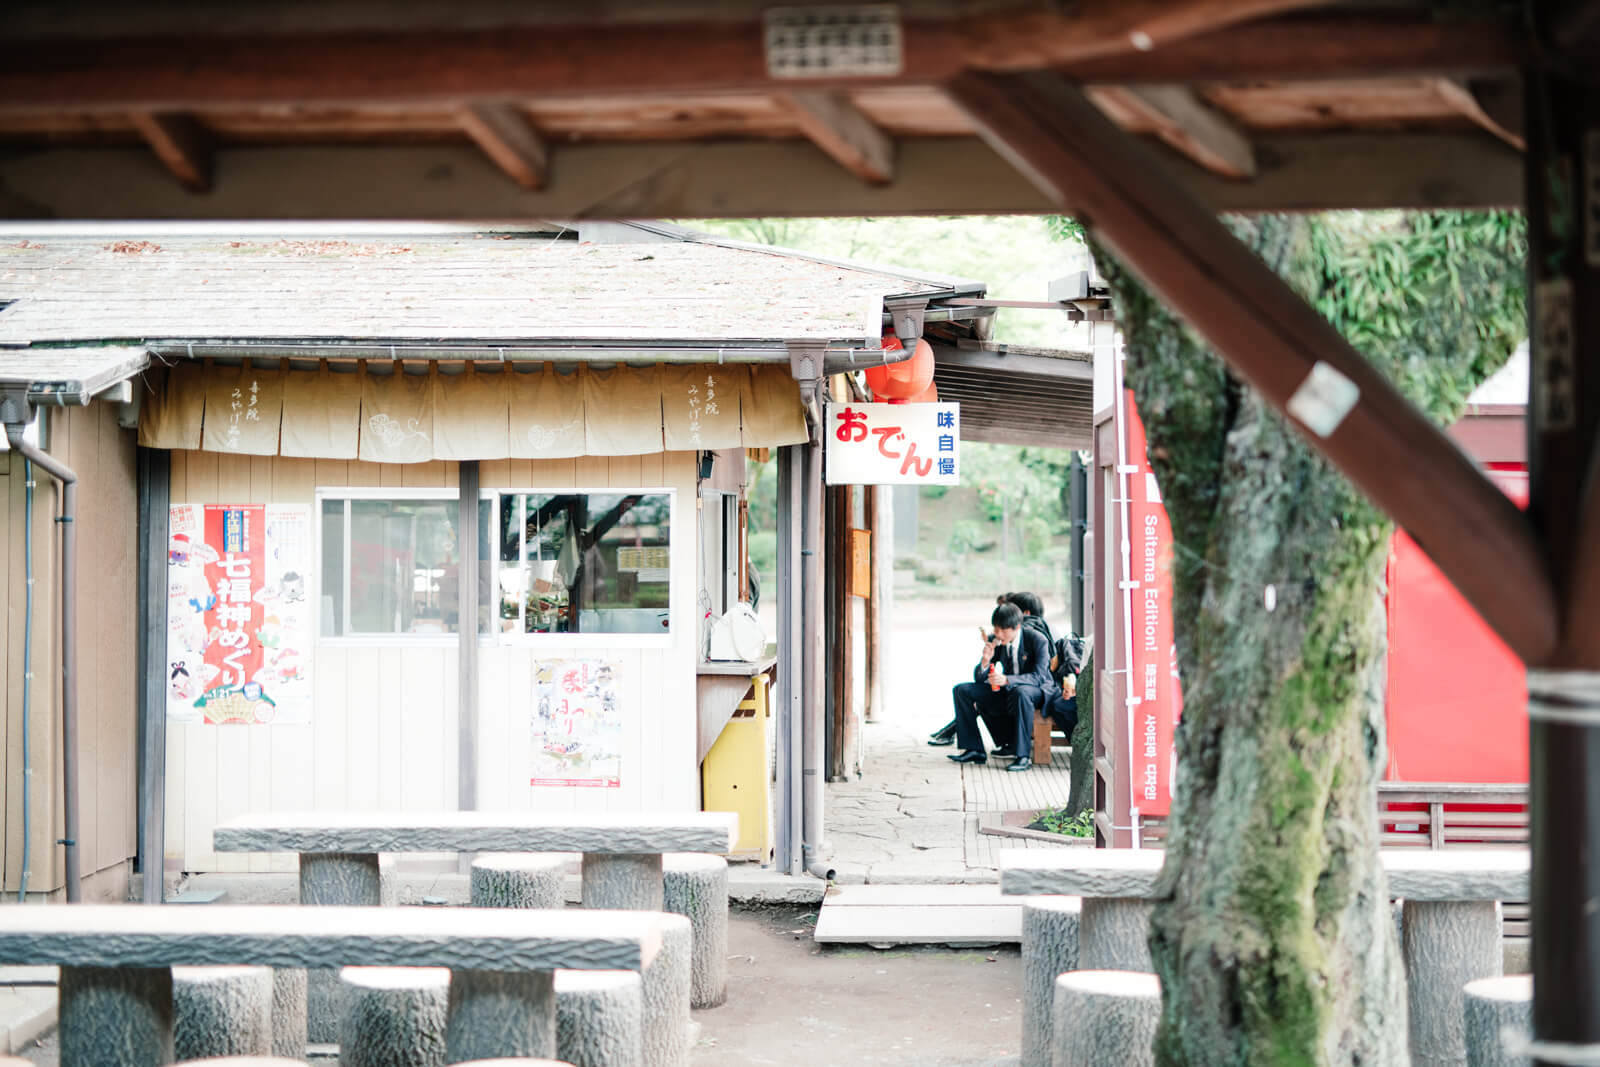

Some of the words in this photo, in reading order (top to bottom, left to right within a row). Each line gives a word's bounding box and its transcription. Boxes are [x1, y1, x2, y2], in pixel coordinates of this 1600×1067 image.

[247, 380, 260, 421] 喜多院
[704, 375, 720, 415] 喜多院
[836, 407, 933, 476] おでん
[937, 410, 955, 475] 味自慢
[1144, 514, 1158, 582] Saitama
[216, 552, 252, 691] 七福神めぐり
[1144, 588, 1158, 652] Edition!
